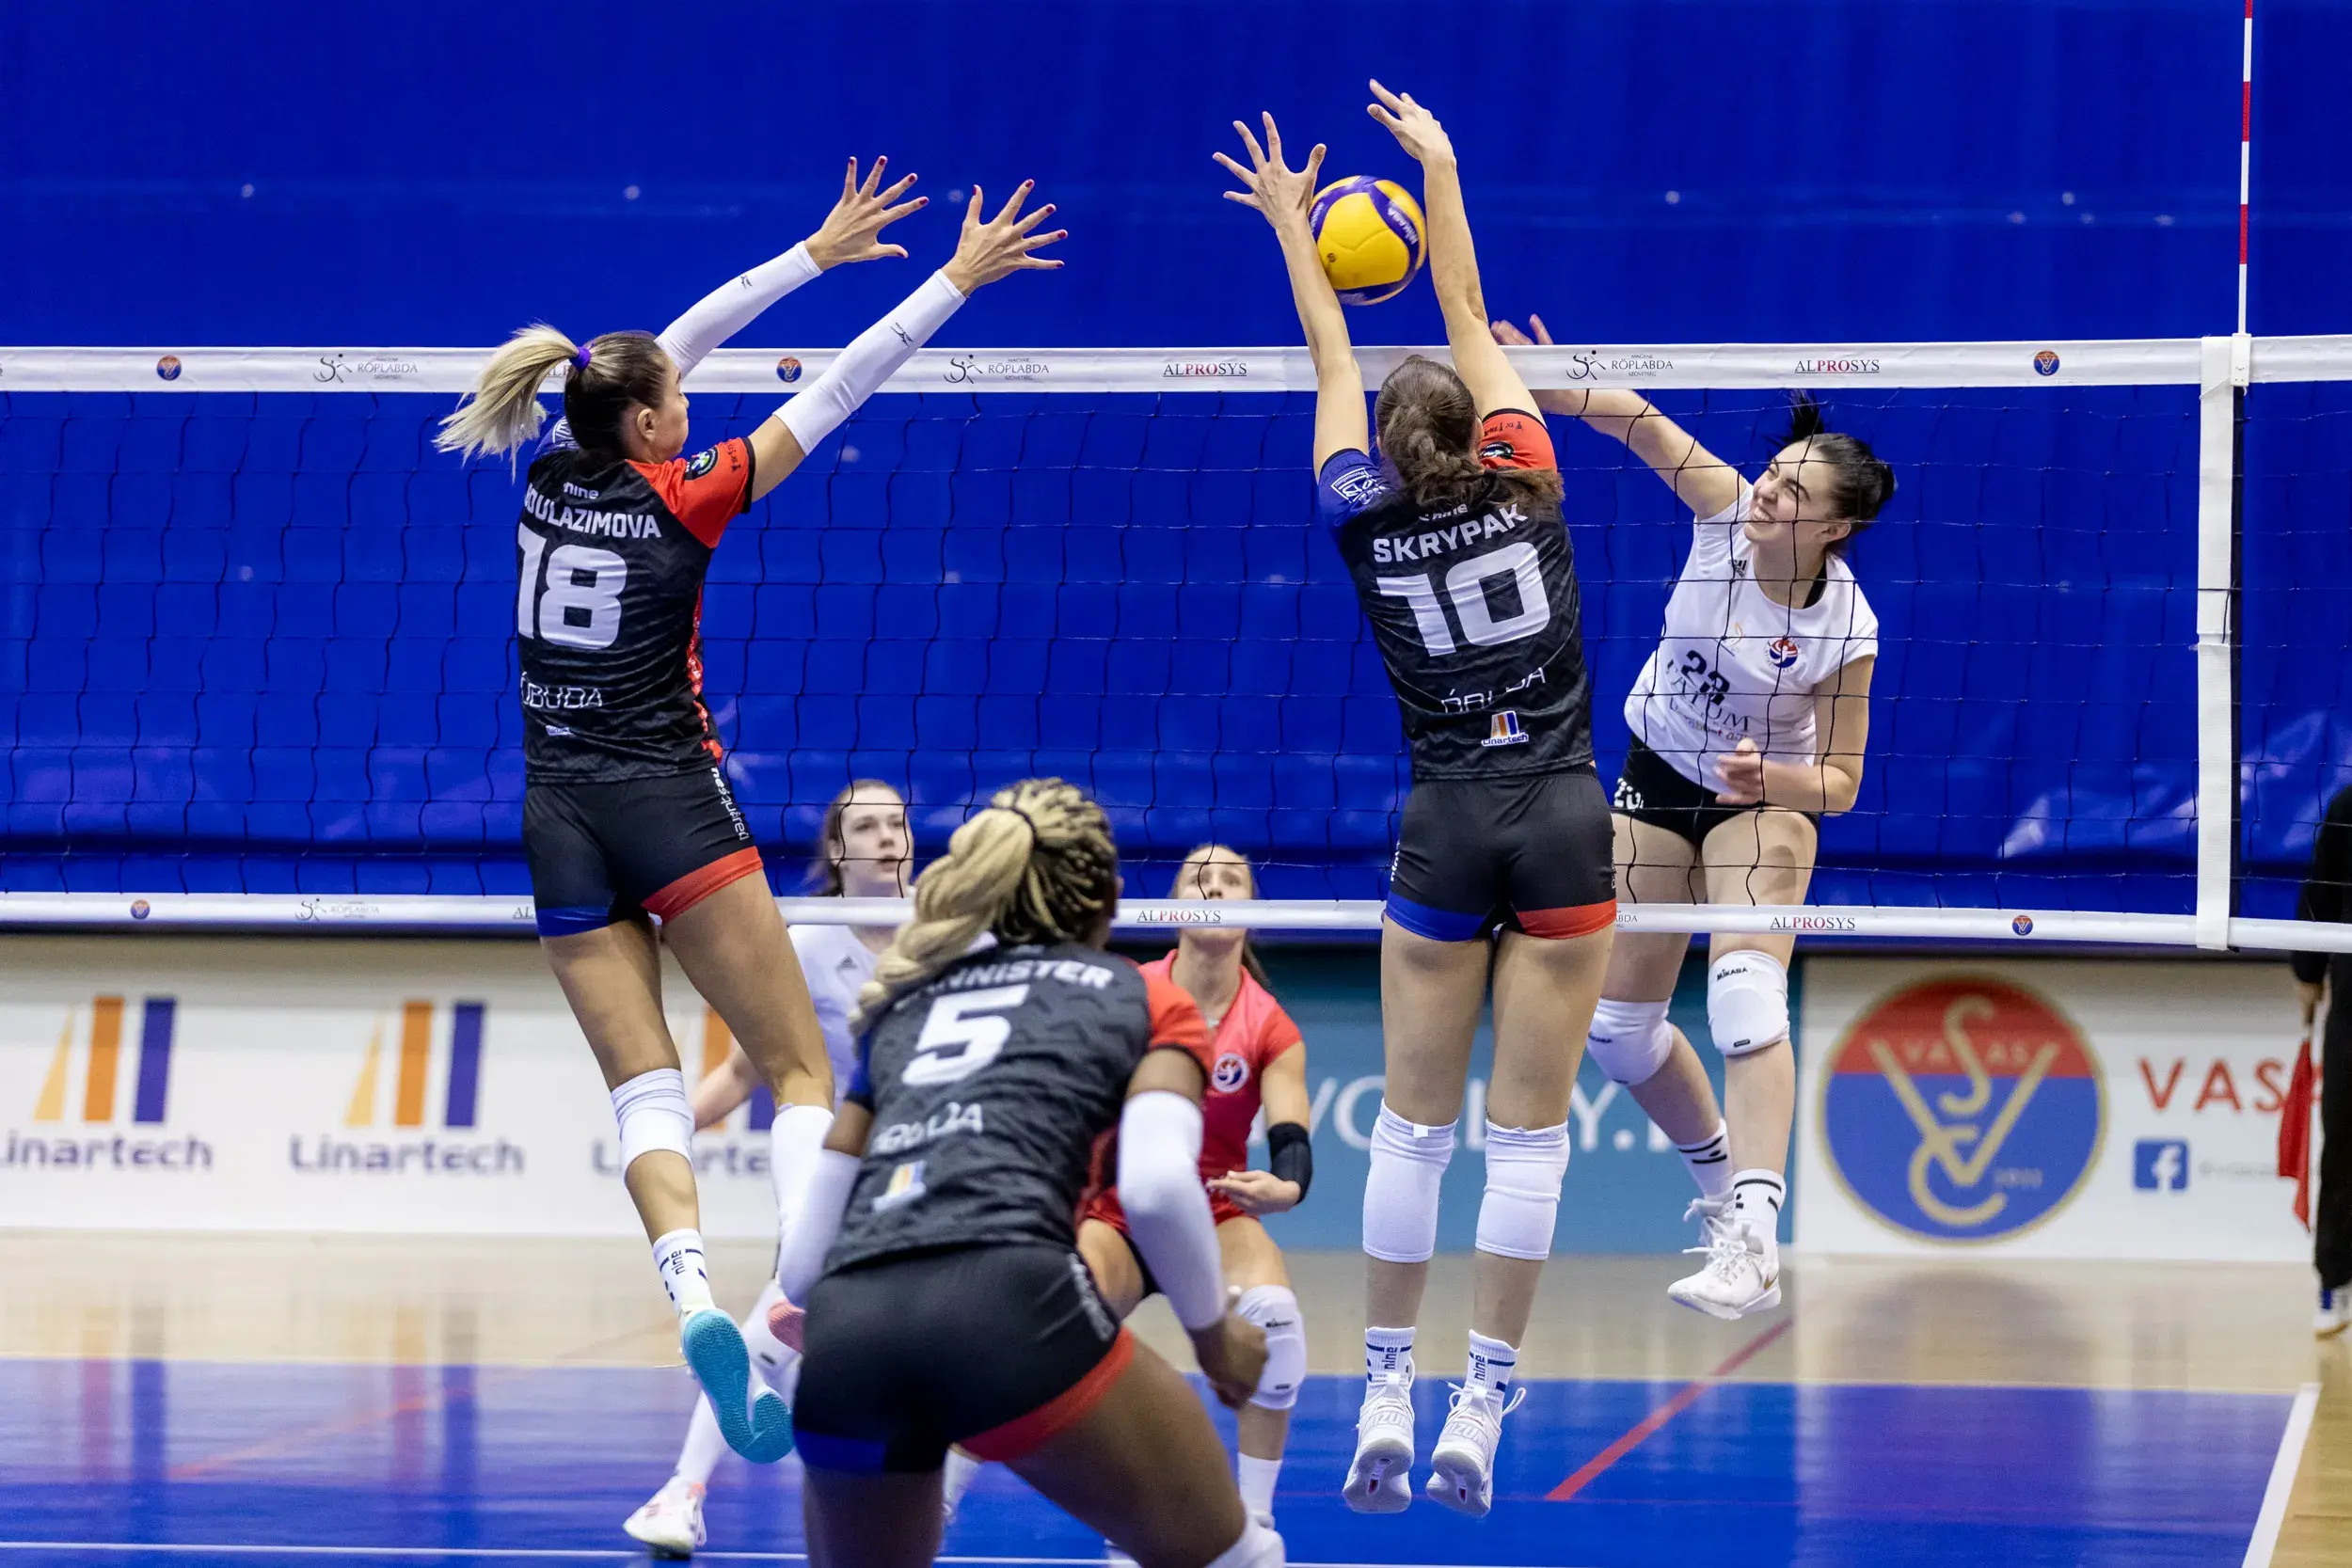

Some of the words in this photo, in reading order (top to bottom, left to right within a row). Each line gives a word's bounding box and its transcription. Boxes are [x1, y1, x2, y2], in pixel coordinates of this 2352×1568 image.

[1163, 362, 1248, 375] ALPROSYS
[1795, 358, 1880, 372] ALPROSYS
[563, 481, 600, 499] nine
[1373, 503, 1529, 562] SKRYPAK
[518, 521, 628, 650] 18
[1376, 542, 1551, 657] 10
[1136, 910, 1221, 922] ALPROSYS
[1770, 916, 1855, 929] ALPROSYS
[900, 984, 1031, 1087] 5
[2137, 1056, 2323, 1113] VAS
[0, 1129, 214, 1170] inartech
[290, 1132, 524, 1174] Linartech
[671, 1249, 686, 1275] nine
[1381, 1346, 1398, 1370] nine
[1472, 1354, 1488, 1382] nine
